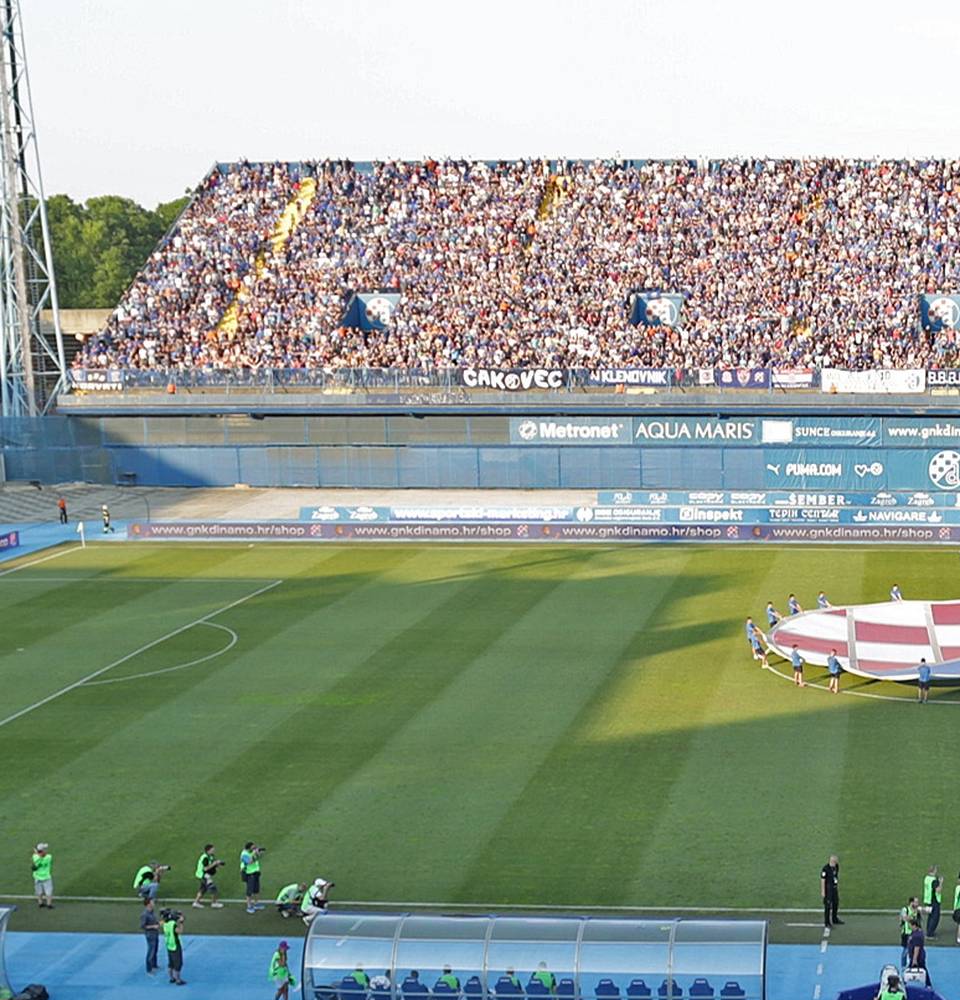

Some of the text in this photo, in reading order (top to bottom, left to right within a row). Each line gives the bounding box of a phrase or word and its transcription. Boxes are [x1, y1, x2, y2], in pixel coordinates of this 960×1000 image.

[540, 422, 618, 438] Metronet
[635, 421, 752, 439] AQUA MARIS
[795, 427, 831, 437] SUNCE
[786, 463, 841, 477] PUMA.COM
[694, 508, 743, 521] inspekt
[869, 511, 927, 522] NAVIGARE
[152, 524, 304, 536] www.gnkdinamo.hr/shop
[355, 524, 511, 537] www.gnkdinamo.hr/shop
[562, 526, 721, 537] www.gnkdinamo.hr/shop
[773, 527, 933, 539] www.gnkdinamo.hr/shop
